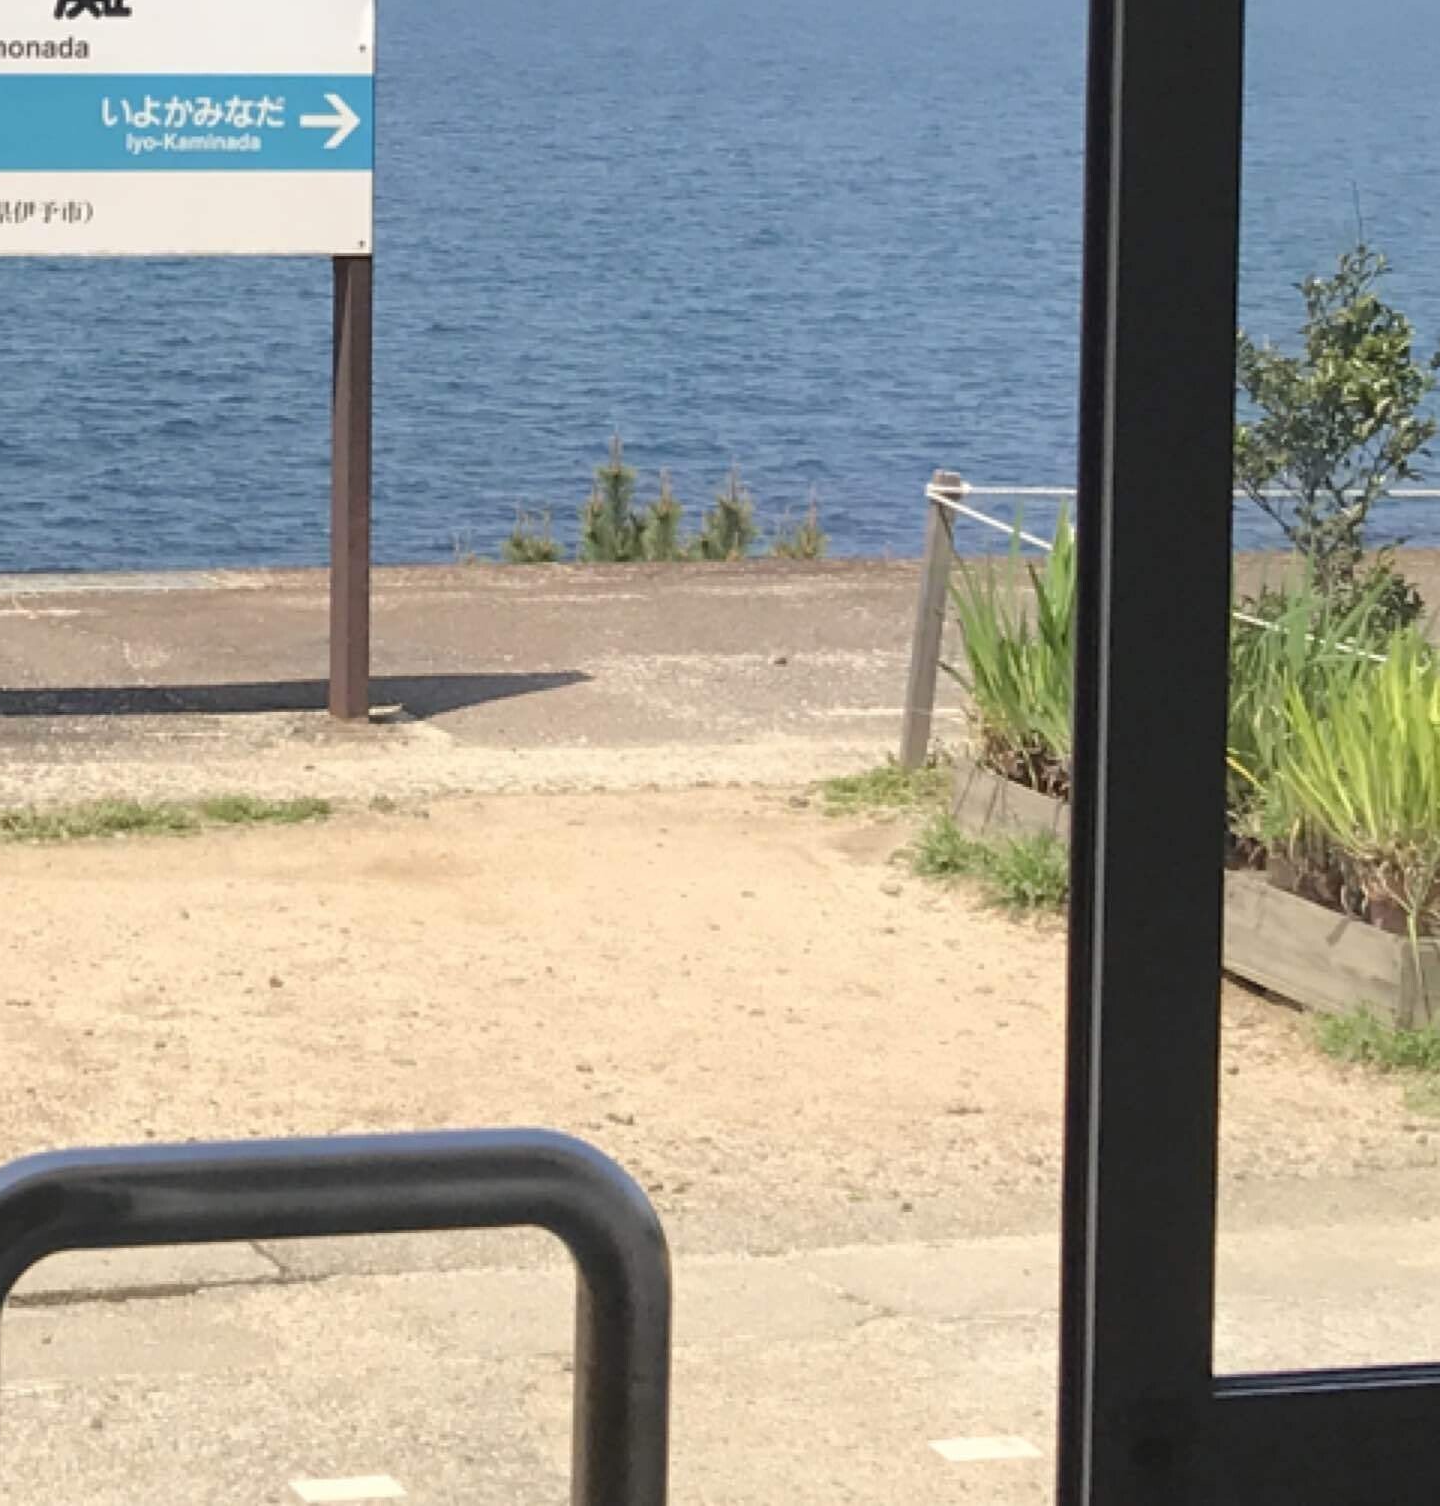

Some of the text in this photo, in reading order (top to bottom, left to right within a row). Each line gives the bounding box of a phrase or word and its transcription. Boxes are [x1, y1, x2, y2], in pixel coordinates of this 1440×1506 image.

[102, 95, 284, 128] いよかみなだ
[126, 133, 262, 155] Iyo-Kaminada
